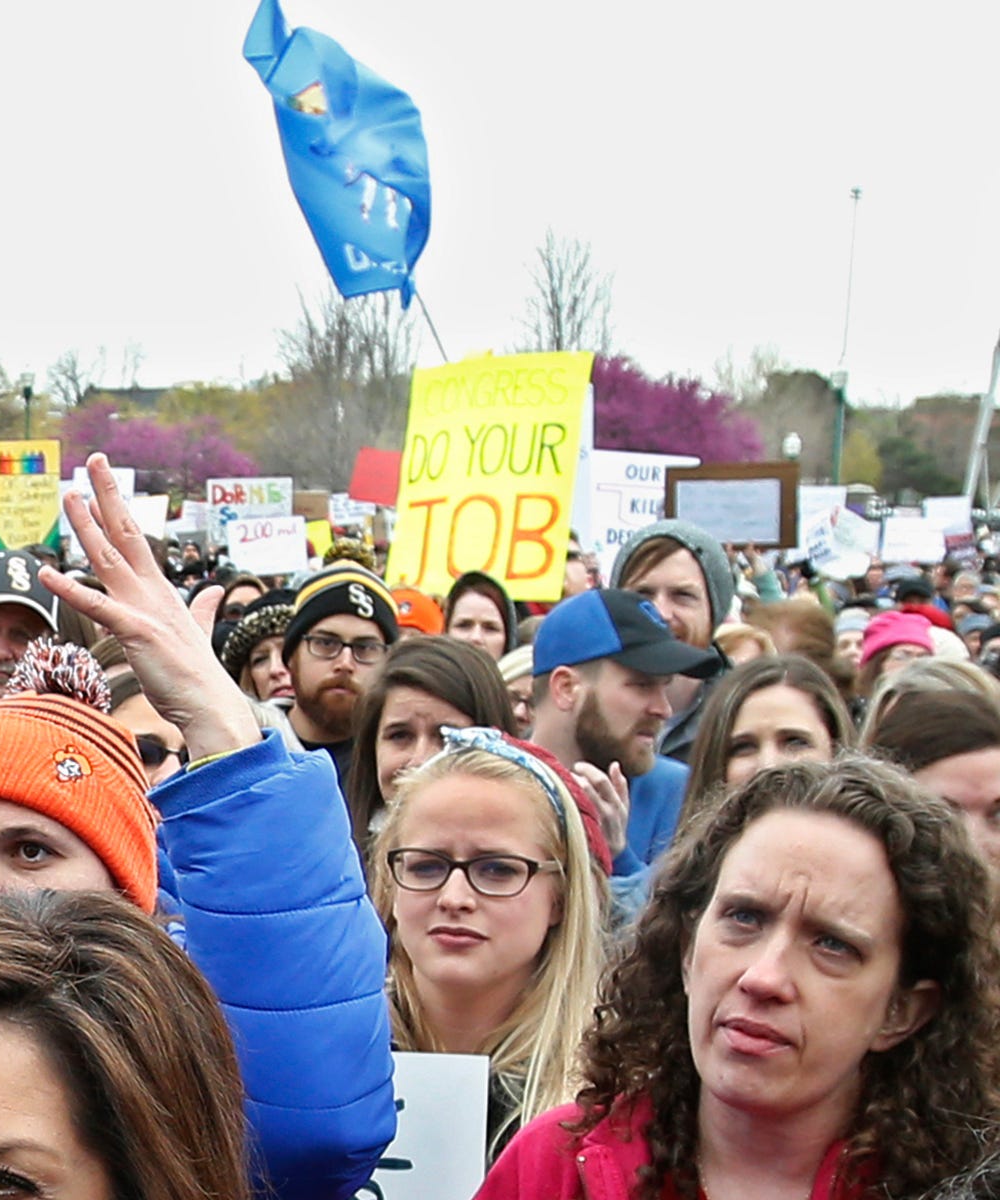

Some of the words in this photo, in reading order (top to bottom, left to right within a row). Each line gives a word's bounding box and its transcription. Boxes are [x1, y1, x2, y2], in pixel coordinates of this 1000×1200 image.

[424, 367, 570, 417] CONGRESS
[408, 430, 450, 483] DO
[465, 423, 567, 477] YOUR
[625, 464, 661, 481] OUR
[401, 493, 560, 586] JOB
